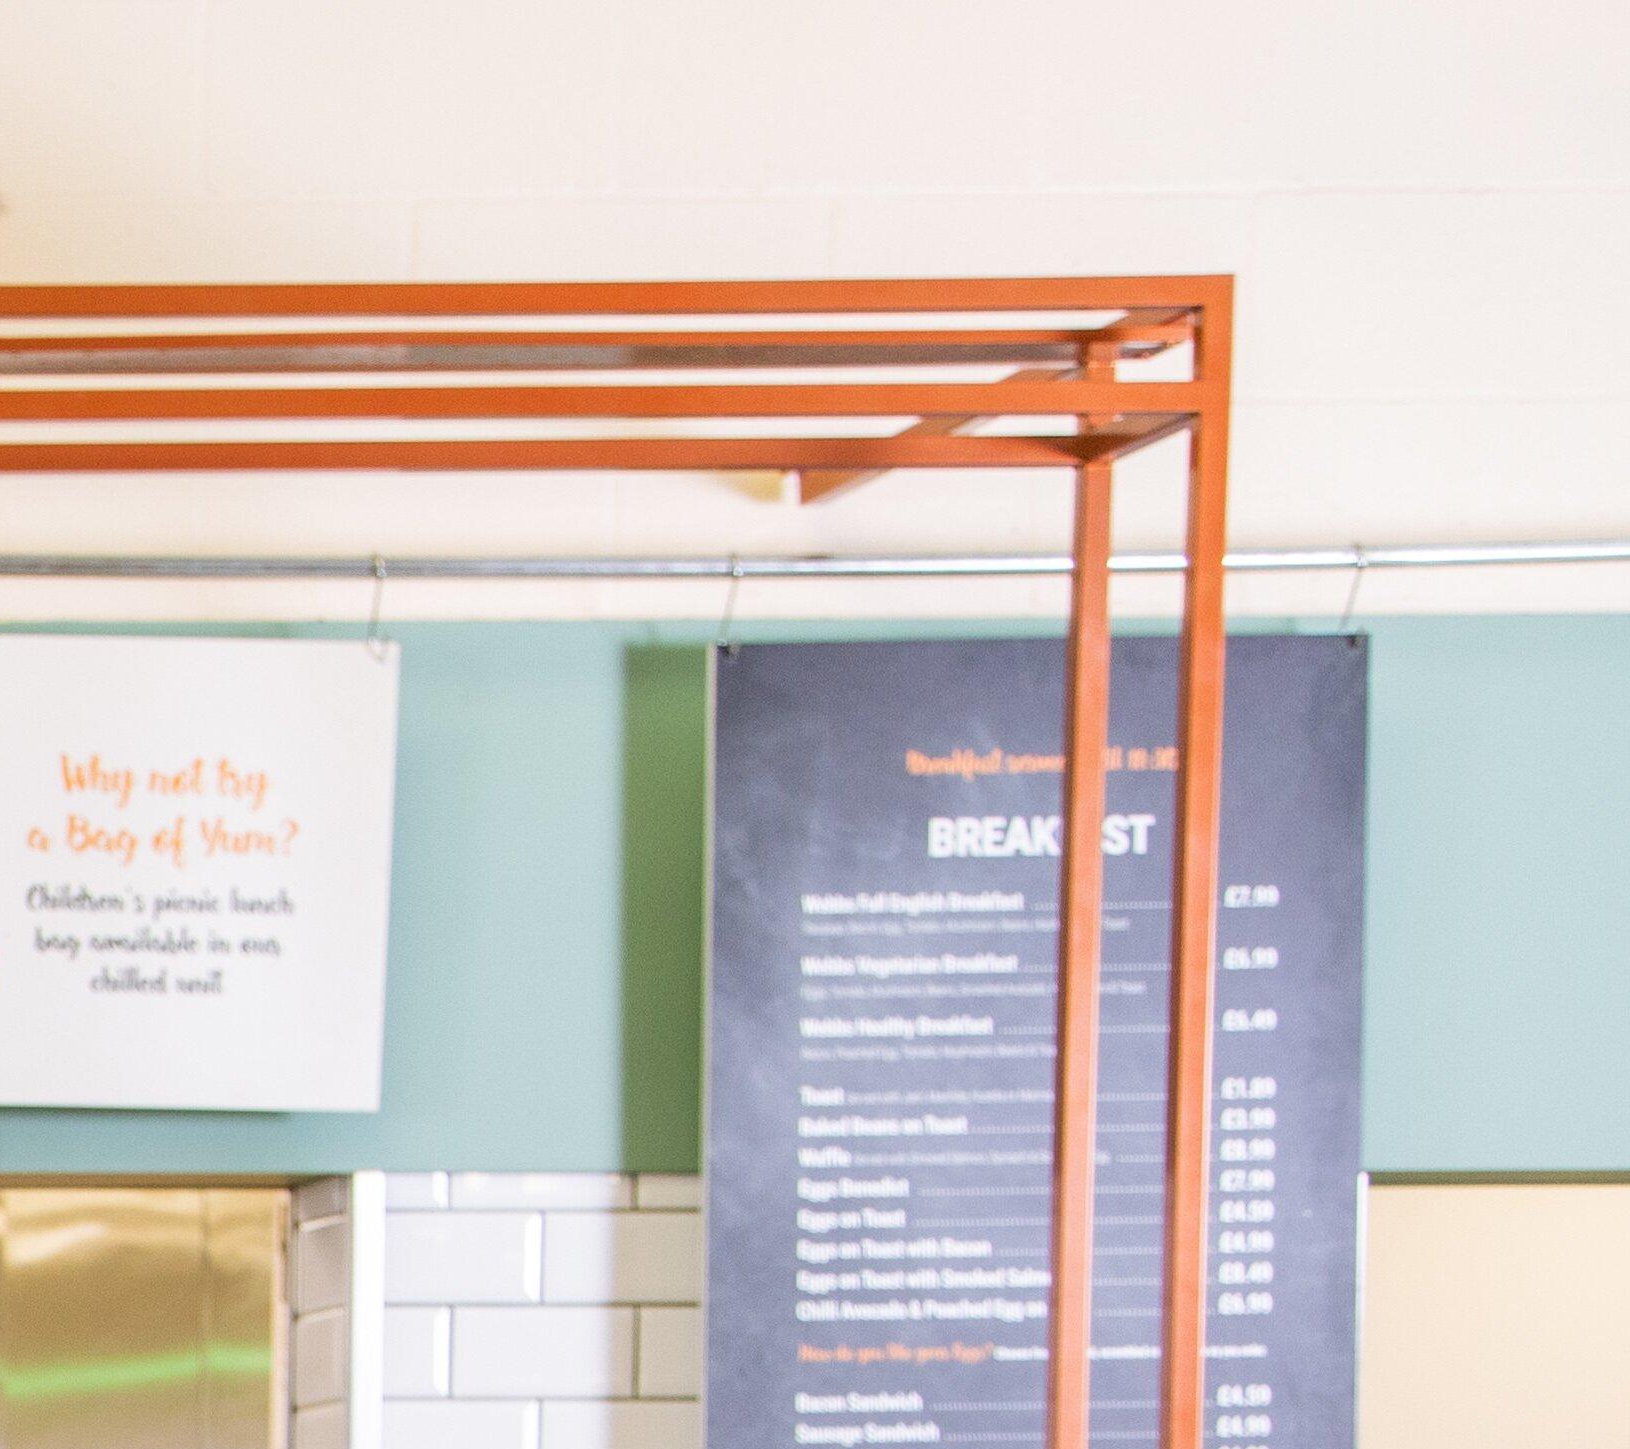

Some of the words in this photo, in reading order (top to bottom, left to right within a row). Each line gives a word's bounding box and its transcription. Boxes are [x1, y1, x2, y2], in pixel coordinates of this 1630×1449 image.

[60, 754, 134, 809] Why
[148, 757, 204, 795] not
[217, 757, 269, 810] try
[27, 825, 49, 852] a
[67, 814, 138, 868] Bag
[152, 815, 185, 869] of
[200, 817, 299, 856] Yum?
[927, 814, 1156, 858] BREAKST
[152, 888, 219, 921] picnic
[230, 886, 295, 914] lunch
[35, 925, 80, 960] bag
[88, 926, 196, 953] available
[207, 931, 230, 953] in
[90, 966, 167, 993] chilled
[175, 969, 222, 993] unit
[923, 1113, 968, 1136] Toast
[839, 1211, 861, 1228] on
[861, 1207, 906, 1228] Toast
[846, 1390, 923, 1413] Sandwich
[863, 1421, 941, 1444] Sandwich
